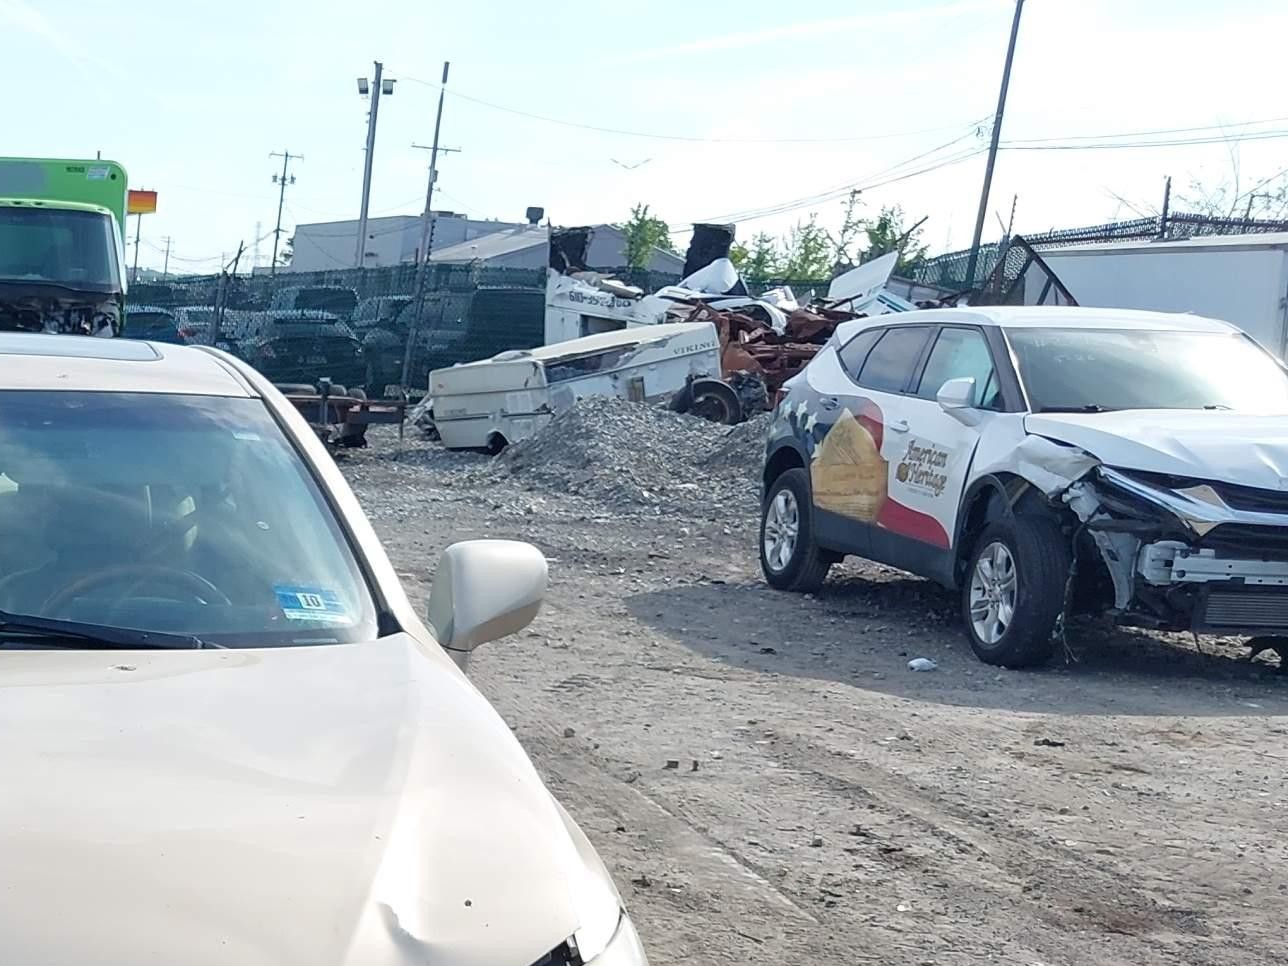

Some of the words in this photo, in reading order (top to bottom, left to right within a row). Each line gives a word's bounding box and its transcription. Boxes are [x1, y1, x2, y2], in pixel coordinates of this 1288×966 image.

[903, 440, 947, 468] American
[909, 462, 947, 497] Heritage
[302, 594, 321, 607] 10
